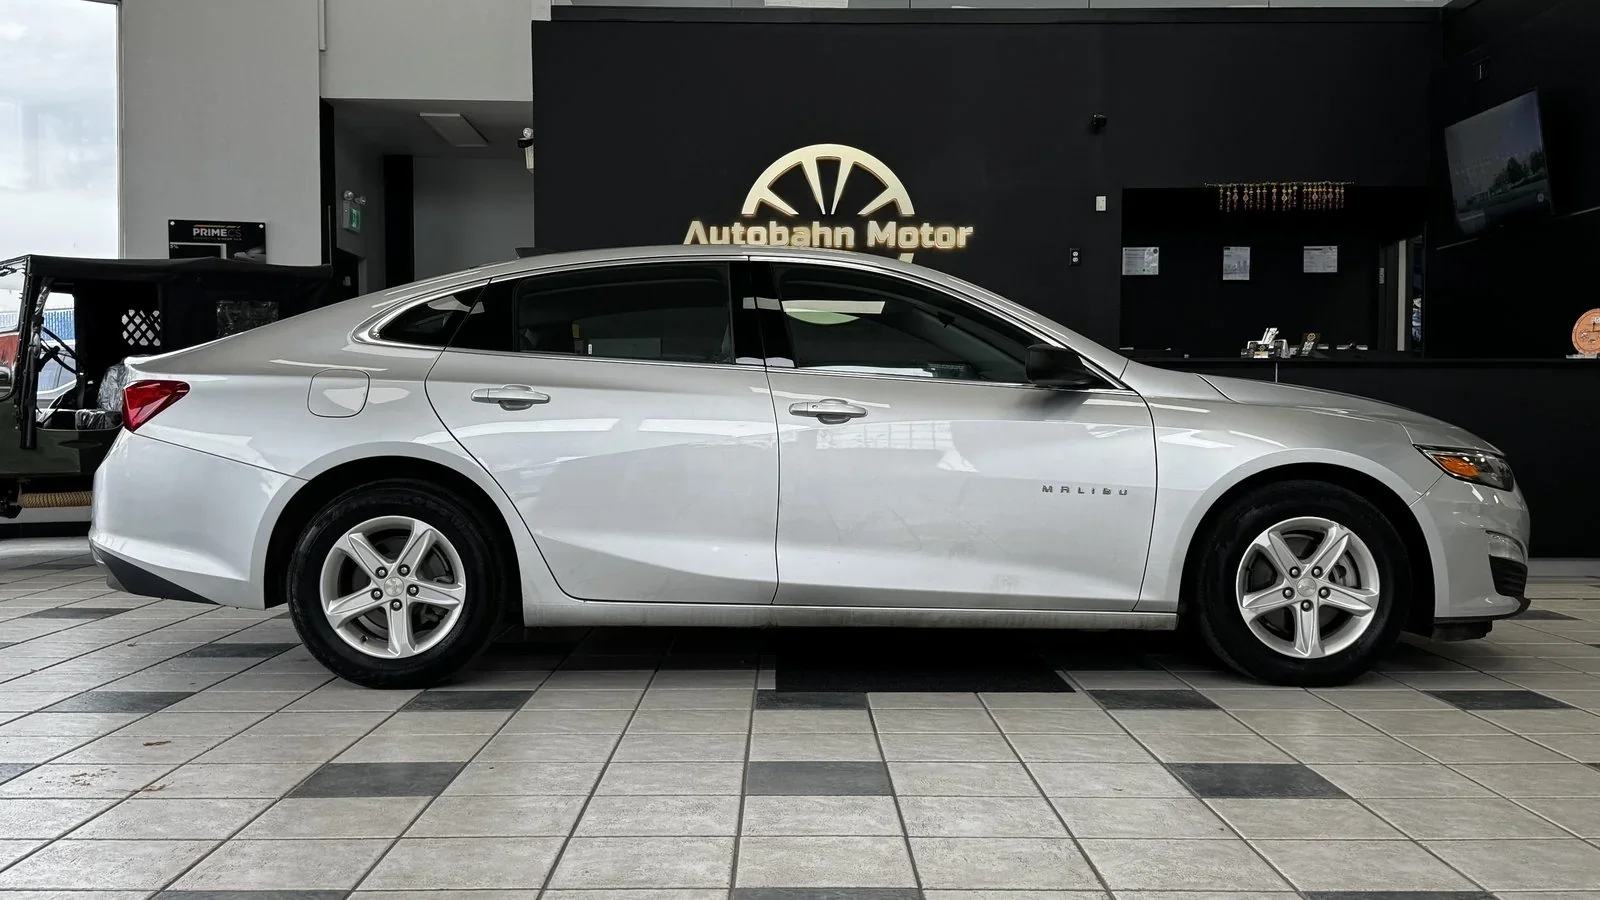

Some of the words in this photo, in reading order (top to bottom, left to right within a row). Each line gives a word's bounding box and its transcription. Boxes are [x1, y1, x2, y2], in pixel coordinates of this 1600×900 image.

[683, 221, 855, 248] Autobahn
[867, 221, 973, 249] Motor
[1042, 485, 1128, 496] MALIBU
